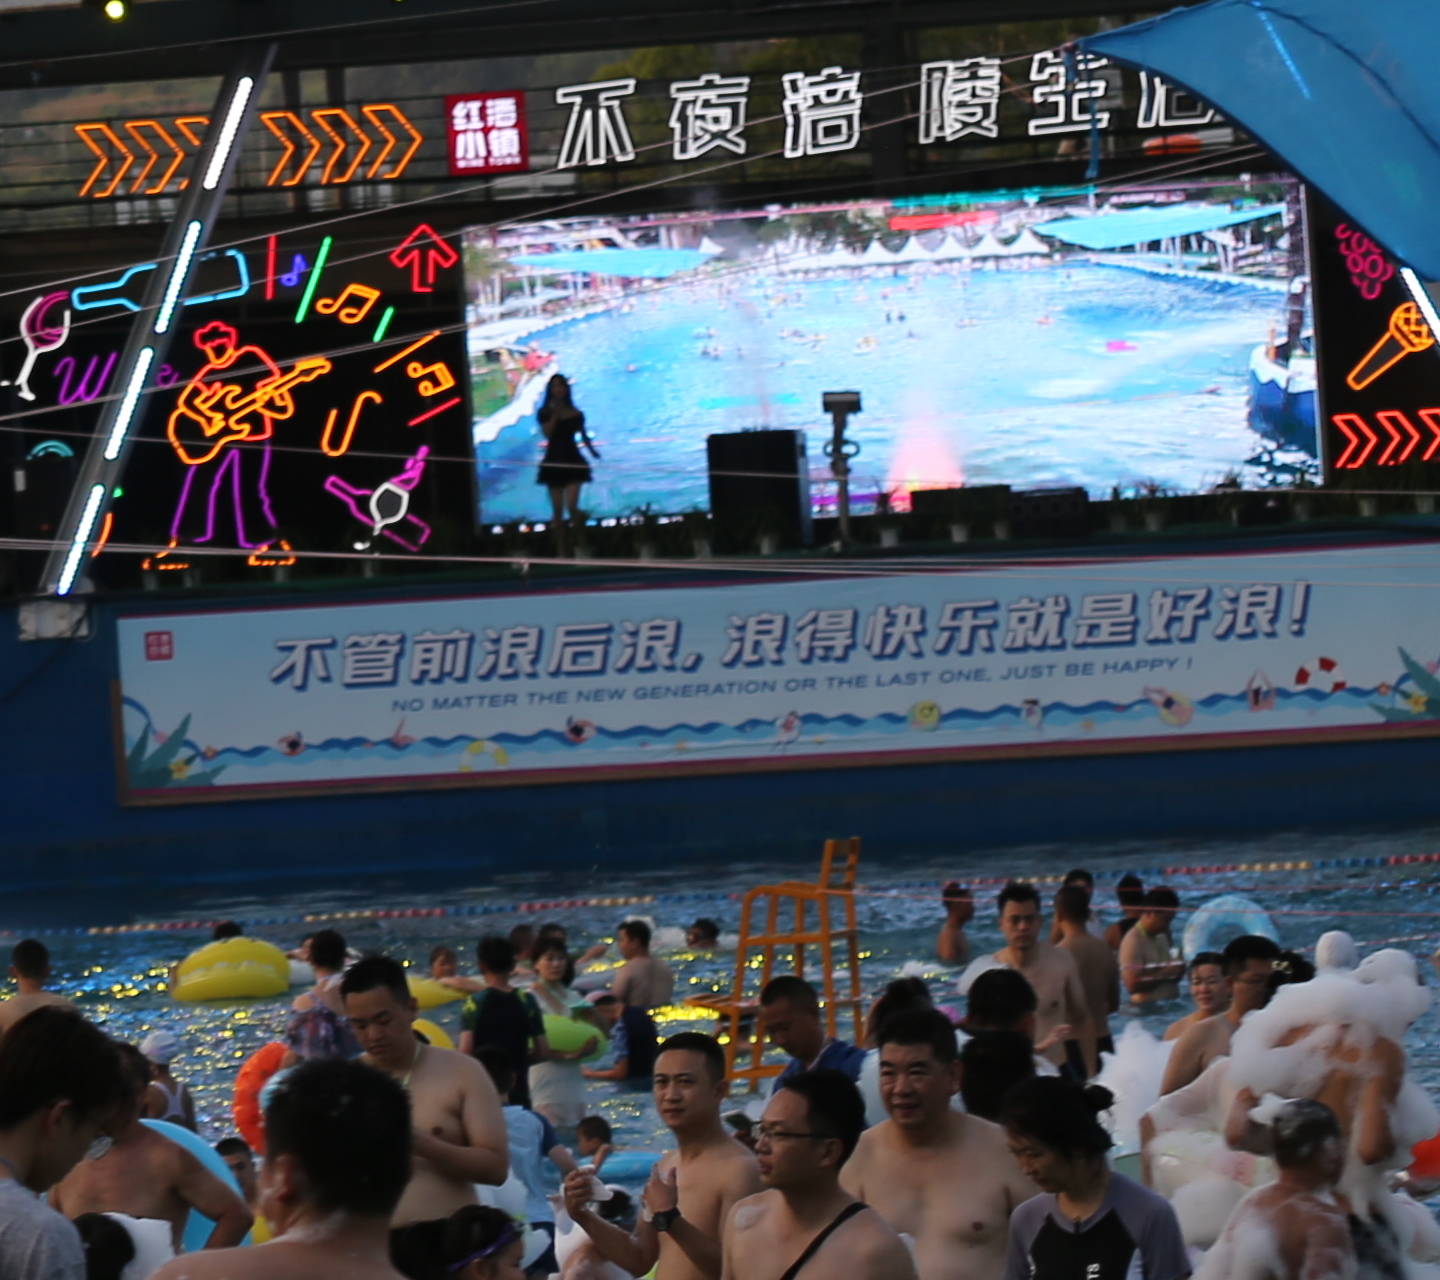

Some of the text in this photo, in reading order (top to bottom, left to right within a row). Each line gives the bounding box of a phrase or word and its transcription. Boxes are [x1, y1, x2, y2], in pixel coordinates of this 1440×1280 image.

[392, 699, 425, 713] NO
[431, 693, 518, 711] MATTER
[528, 691, 569, 706] THE
[576, 688, 625, 704] NEW
[633, 679, 776, 702] GENERATION
[784, 677, 818, 692] OR
[824, 674, 870, 690] THE
[876, 670, 930, 688] LAST
[1000, 663, 1057, 681] JUST
[1064, 661, 1094, 677] BE
